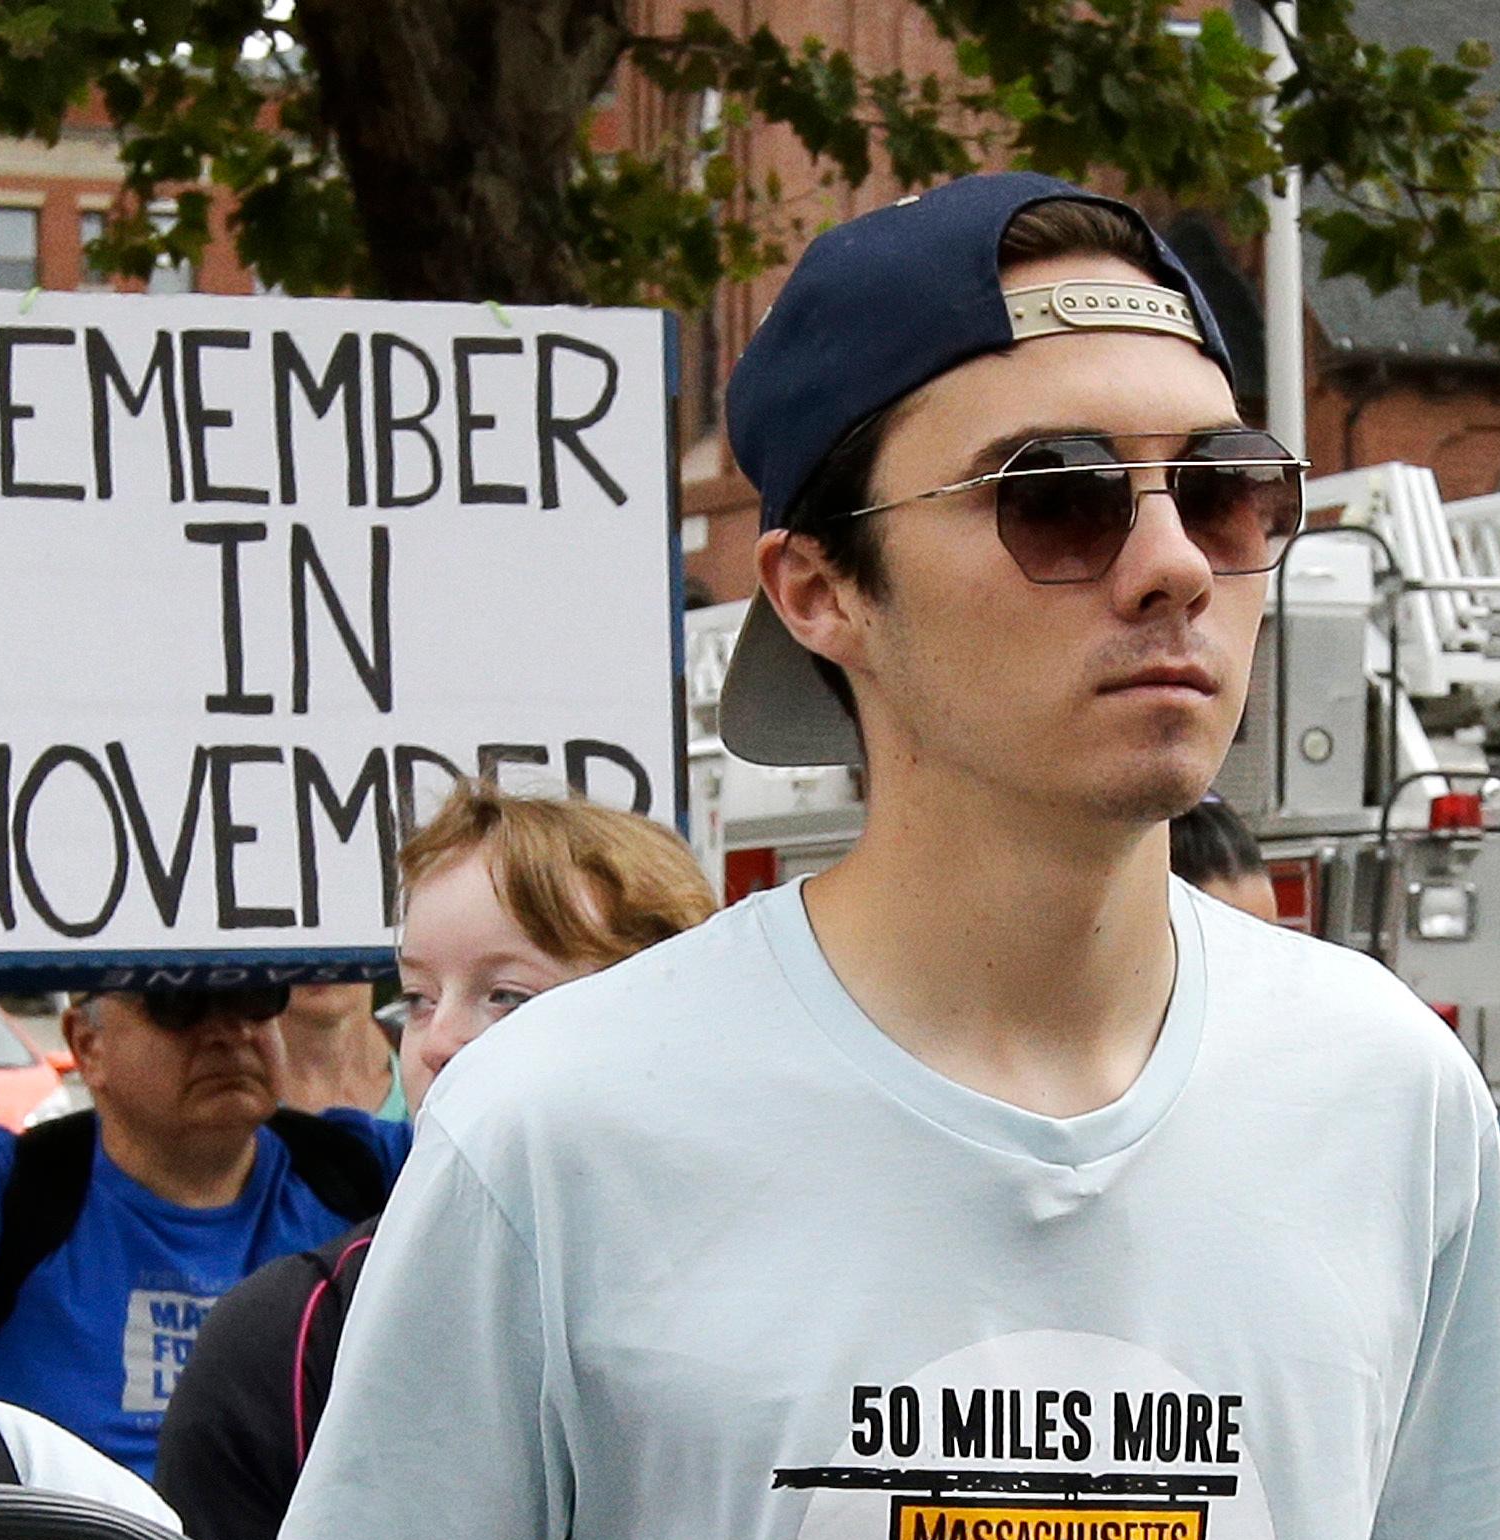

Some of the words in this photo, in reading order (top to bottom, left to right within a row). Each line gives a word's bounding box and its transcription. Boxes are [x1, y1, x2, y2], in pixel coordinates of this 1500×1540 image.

[184, 522, 393, 715] IN
[851, 1384, 921, 1458] 50
[941, 1387, 1093, 1461] MILES
[1113, 1391, 1243, 1464] MORE
